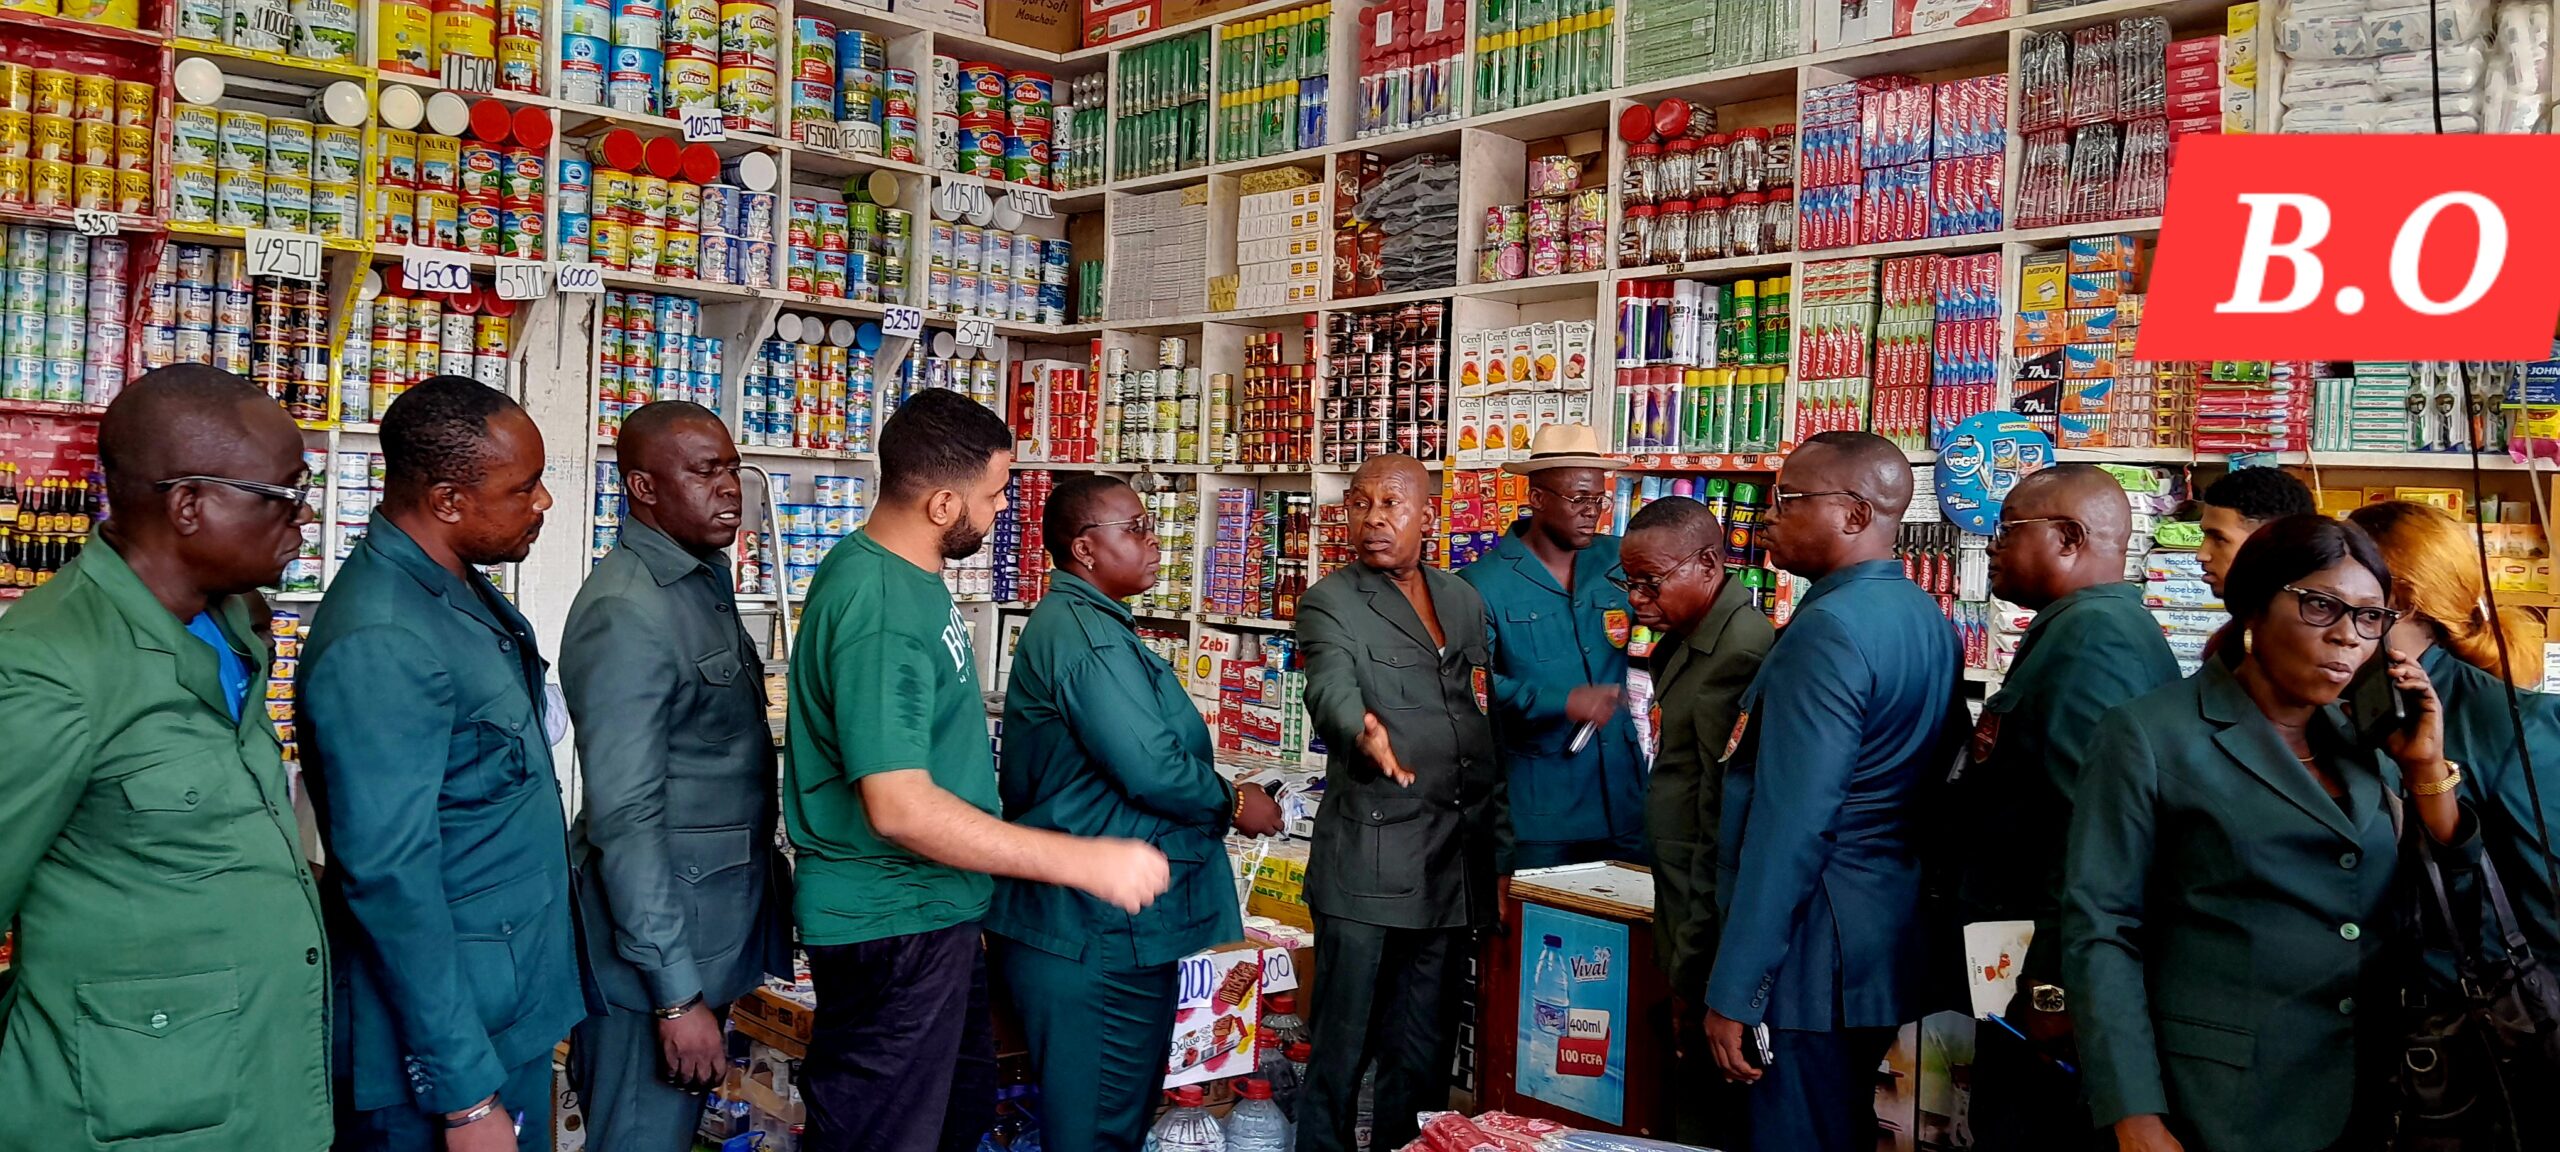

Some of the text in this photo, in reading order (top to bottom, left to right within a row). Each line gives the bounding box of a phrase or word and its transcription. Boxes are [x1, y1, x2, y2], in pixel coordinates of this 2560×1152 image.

[1015, 8, 1058, 26] Mouchoir
[679, 72, 710, 85] Kizola
[1016, 90, 1039, 100] Bridel
[180, 110, 215, 127] Milgro
[227, 117, 262, 133] Milgro
[271, 124, 305, 140] Milgro
[425, 139, 456, 151] NURA
[269, 182, 303, 199] Milgro
[78, 213, 117, 234] 3250
[1878, 195, 1889, 240] Colgate
[1895, 194, 1905, 239] Colgate
[254, 237, 319, 278] 4250
[403, 258, 471, 291] 4500
[560, 264, 599, 288] 6000
[1900, 259, 1908, 298] Colgate
[1914, 258, 1922, 297] Colgate
[1941, 260, 1949, 294] Colgate
[885, 307, 920, 331] 5250
[1565, 324, 1588, 334] Ceres
[1461, 333, 1481, 344] Ceres
[1487, 332, 1507, 342] Ceres
[1511, 328, 1532, 338] Ceres
[1534, 326, 1555, 336] Ceres
[1939, 324, 1947, 358] Colgate
[1954, 323, 1962, 358] Colgate
[1800, 336, 1809, 378] Colgate
[1816, 335, 1825, 377] Colgate
[1832, 334, 1841, 376] Colgate
[1849, 332, 1859, 375] Colgate
[1917, 343, 1926, 383] Colgate
[1876, 347, 1884, 386] Colgate
[1889, 345, 1898, 384] Colgate
[1903, 345, 1912, 384] Colgate
[1460, 399, 1480, 408] Ceres
[1487, 397, 1507, 407] Ceres
[1511, 396, 1531, 406] Ceres
[1538, 395, 1558, 405] Ceres
[1567, 394, 1588, 403] Ceres
[1904, 388, 1912, 428] Colgate
[1918, 387, 1926, 427] Colgate
[1951, 387, 1959, 421] Colgate
[1732, 509, 1752, 523] HIT
[1939, 559, 1948, 592] Colgate
[2164, 585, 2205, 596] Hope baby
[2169, 612, 2211, 624] Hope baby
[1199, 635, 1230, 653] Zebi
[1570, 955, 1608, 978] Vival
[1569, 1017, 1602, 1034] 400ml
[1560, 1048, 1604, 1066] 100 FCFA
